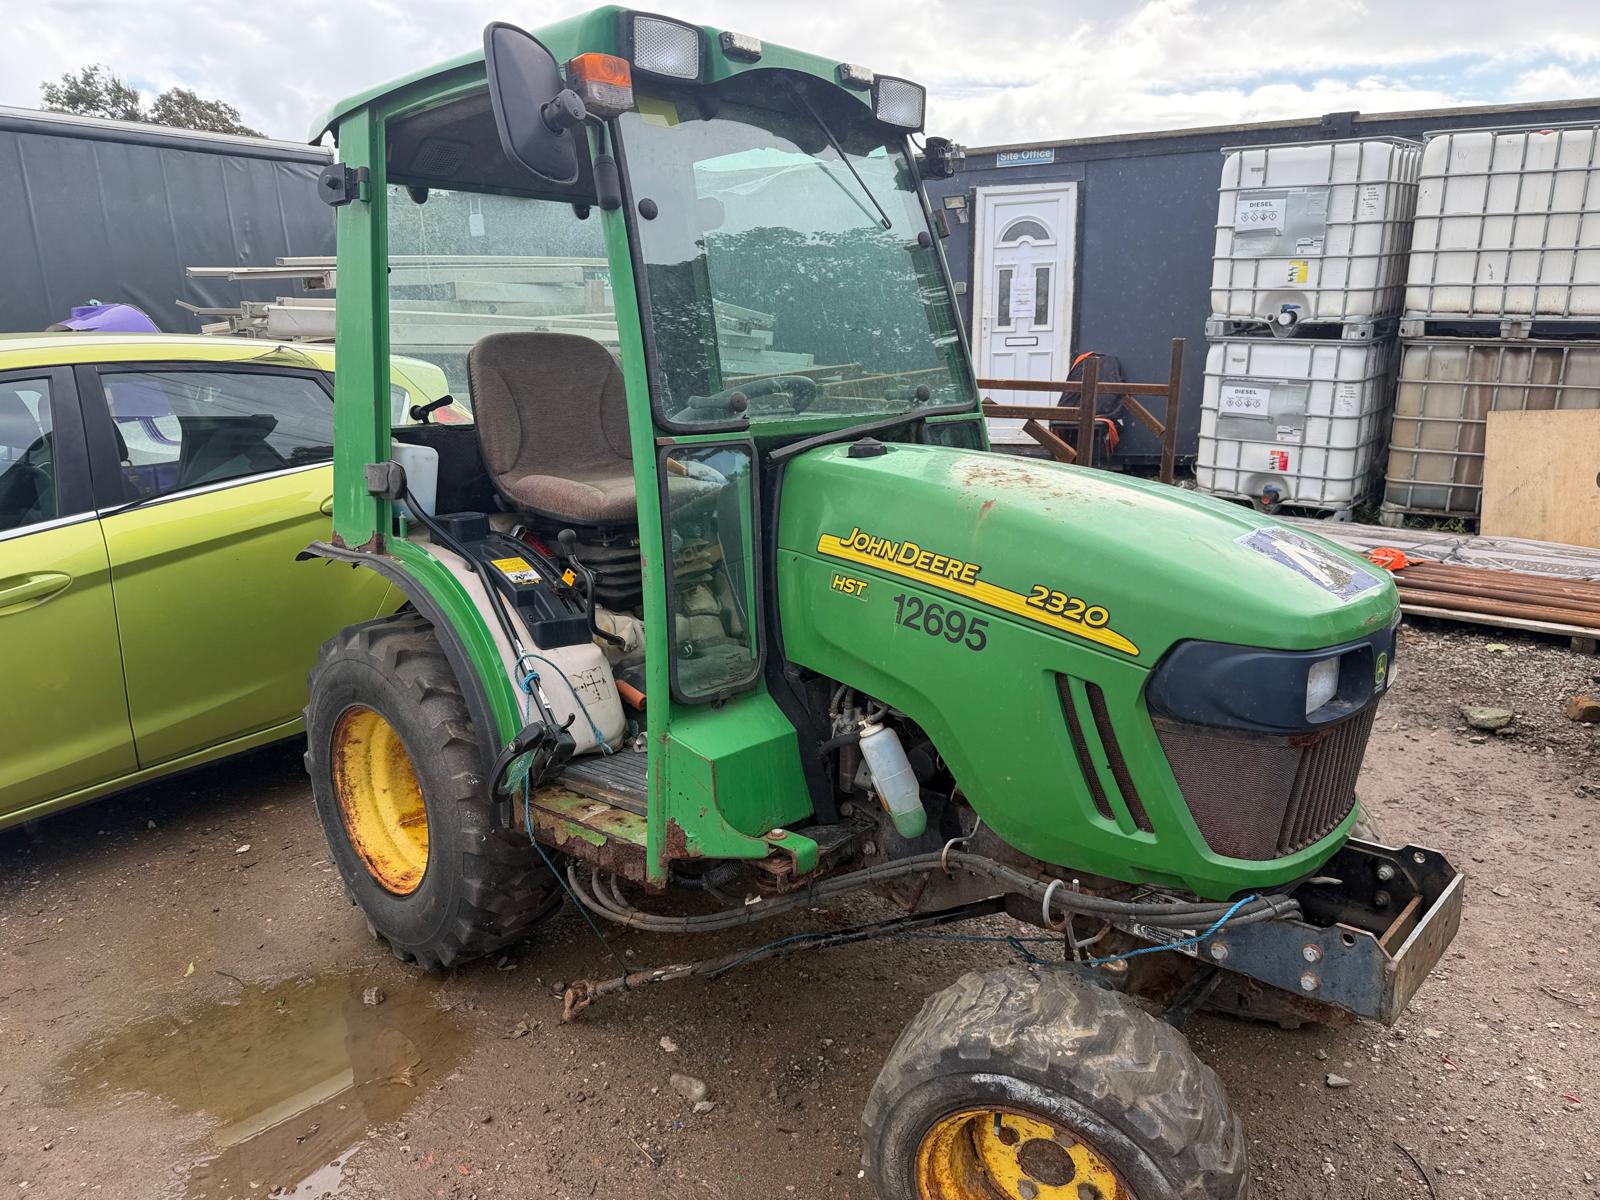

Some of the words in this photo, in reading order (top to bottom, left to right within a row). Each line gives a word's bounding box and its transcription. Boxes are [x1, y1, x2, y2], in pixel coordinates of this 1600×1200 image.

[1000, 152, 1019, 161] Site
[1021, 150, 1051, 159] Office
[840, 526, 900, 562] JOHN
[896, 541, 981, 585] DEERE
[832, 574, 868, 597] HST
[1026, 584, 1110, 629] 2320
[893, 593, 990, 652] 12695
